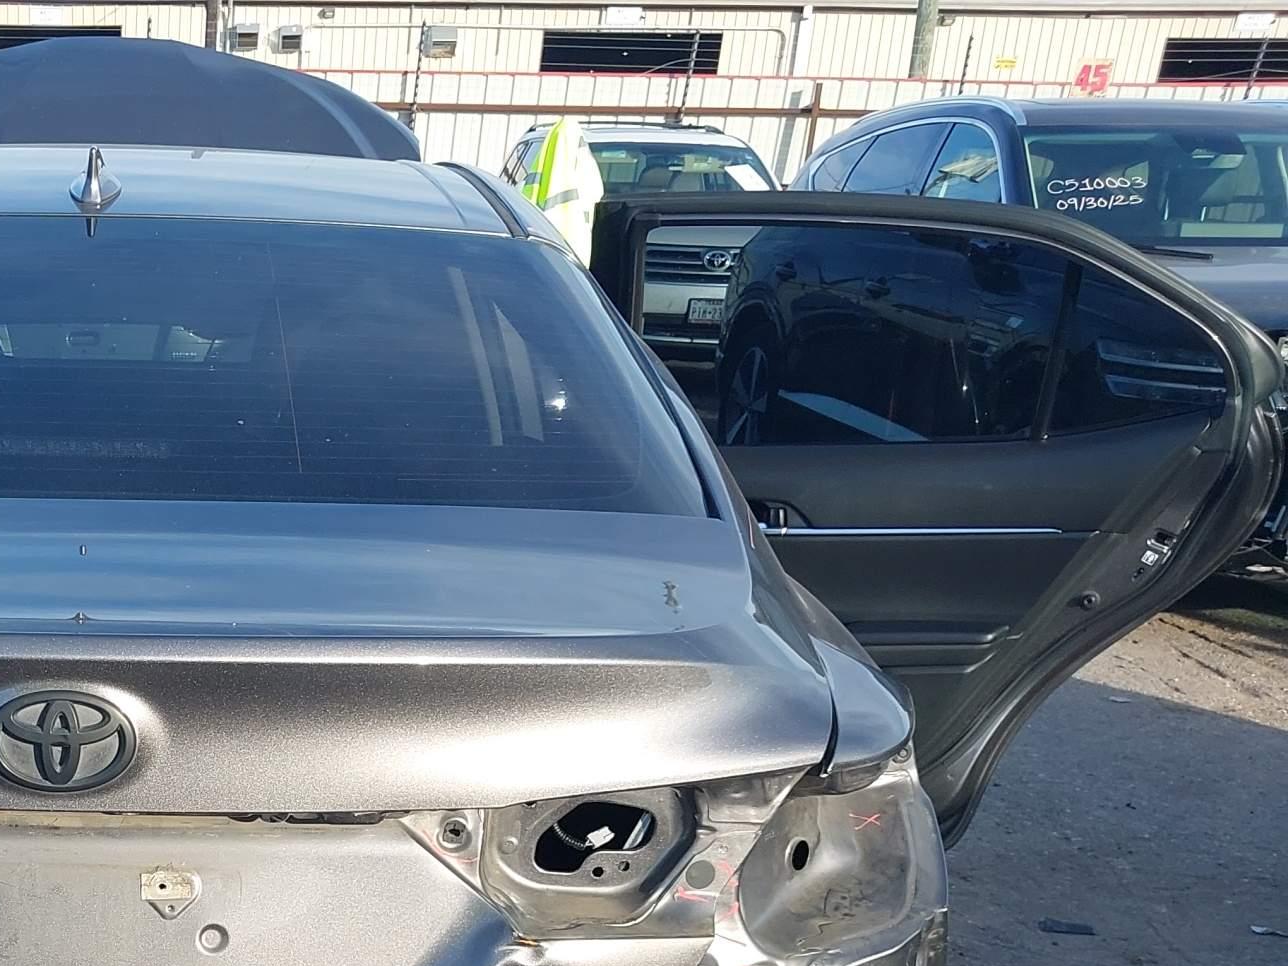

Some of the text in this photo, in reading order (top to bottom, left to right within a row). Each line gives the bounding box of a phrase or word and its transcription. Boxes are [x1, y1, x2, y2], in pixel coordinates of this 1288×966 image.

[1074, 64, 1112, 92] 45
[1047, 176, 1148, 195] C510003
[1056, 194, 1145, 212] 09/30/25
